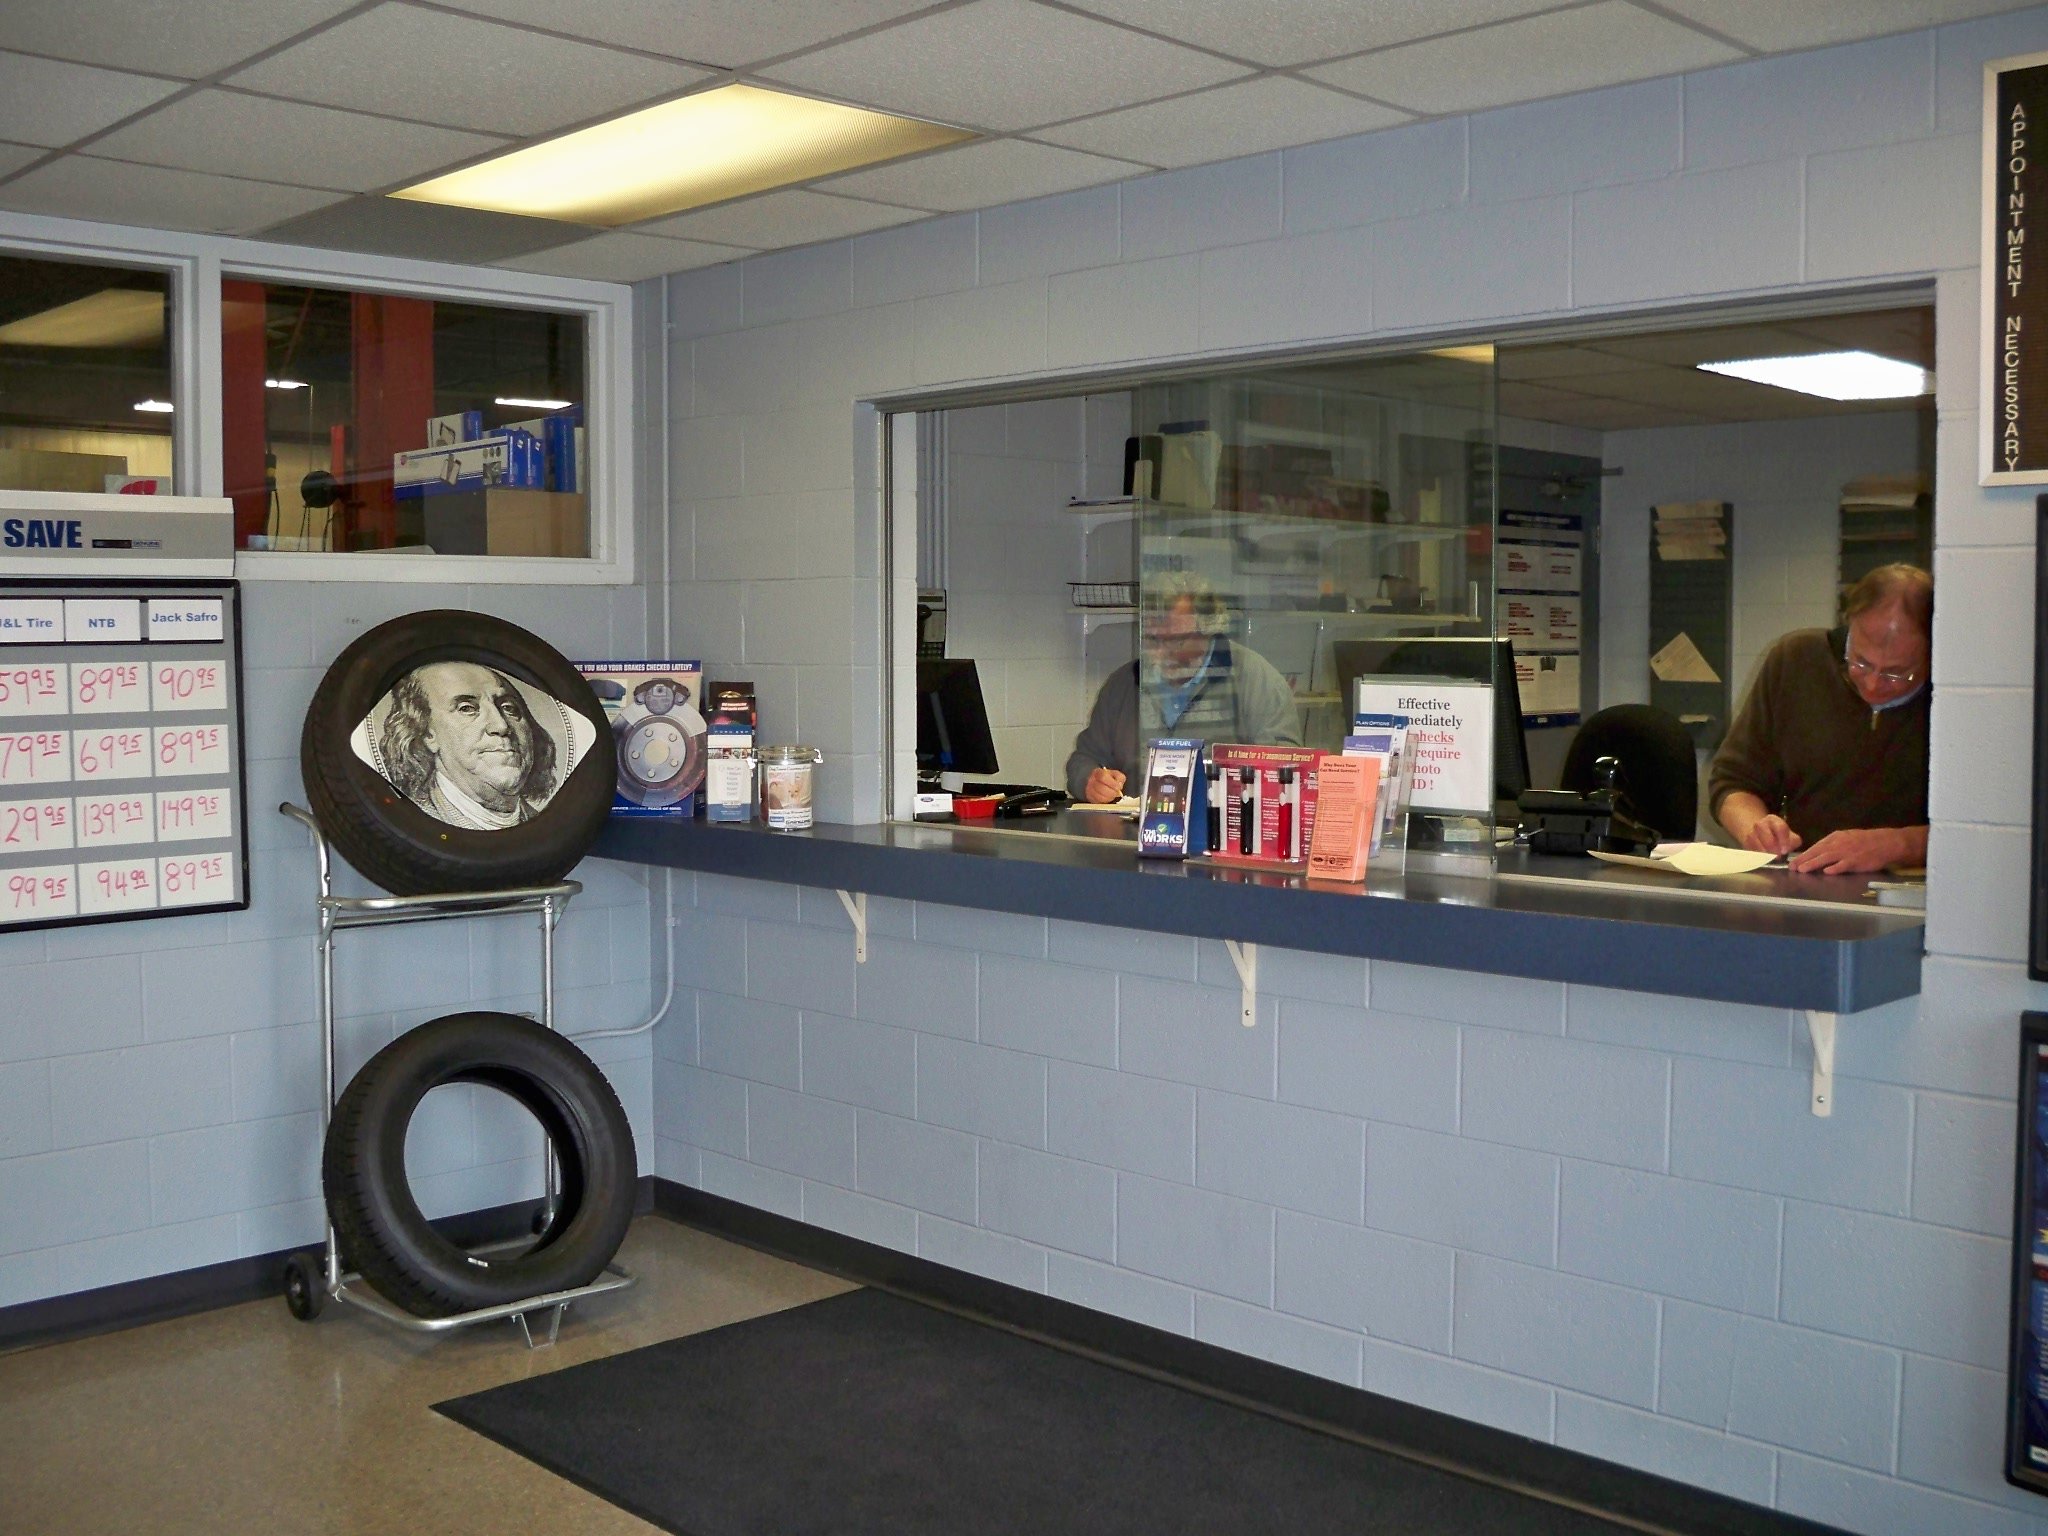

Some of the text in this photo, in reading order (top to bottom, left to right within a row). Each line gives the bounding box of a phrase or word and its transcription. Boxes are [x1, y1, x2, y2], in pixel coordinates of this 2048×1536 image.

[2004, 103, 2027, 473] APPOINTMENT NECESSARY
[4, 518, 83, 549] SAVE
[0, 618, 53, 629] &L Tire
[88, 618, 116, 628] NTB
[152, 612, 218, 623] Jack Safro
[584, 664, 595, 672] YOU
[596, 664, 608, 672] HAD
[608, 664, 623, 672] YOUR
[646, 663, 670, 671] CHECKED
[671, 663, 693, 671] LATELY?
[1397, 698, 1451, 711] Effective
[1413, 729, 1454, 743] checks
[1238, 750, 1249, 758] time
[1248, 751, 1257, 760] for
[1261, 751, 1292, 760] Transmission
[1292, 753, 1315, 762] Service?
[1415, 747, 1461, 761] require
[1411, 778, 1427, 790] ID
[1143, 833, 1184, 844] WORKS
